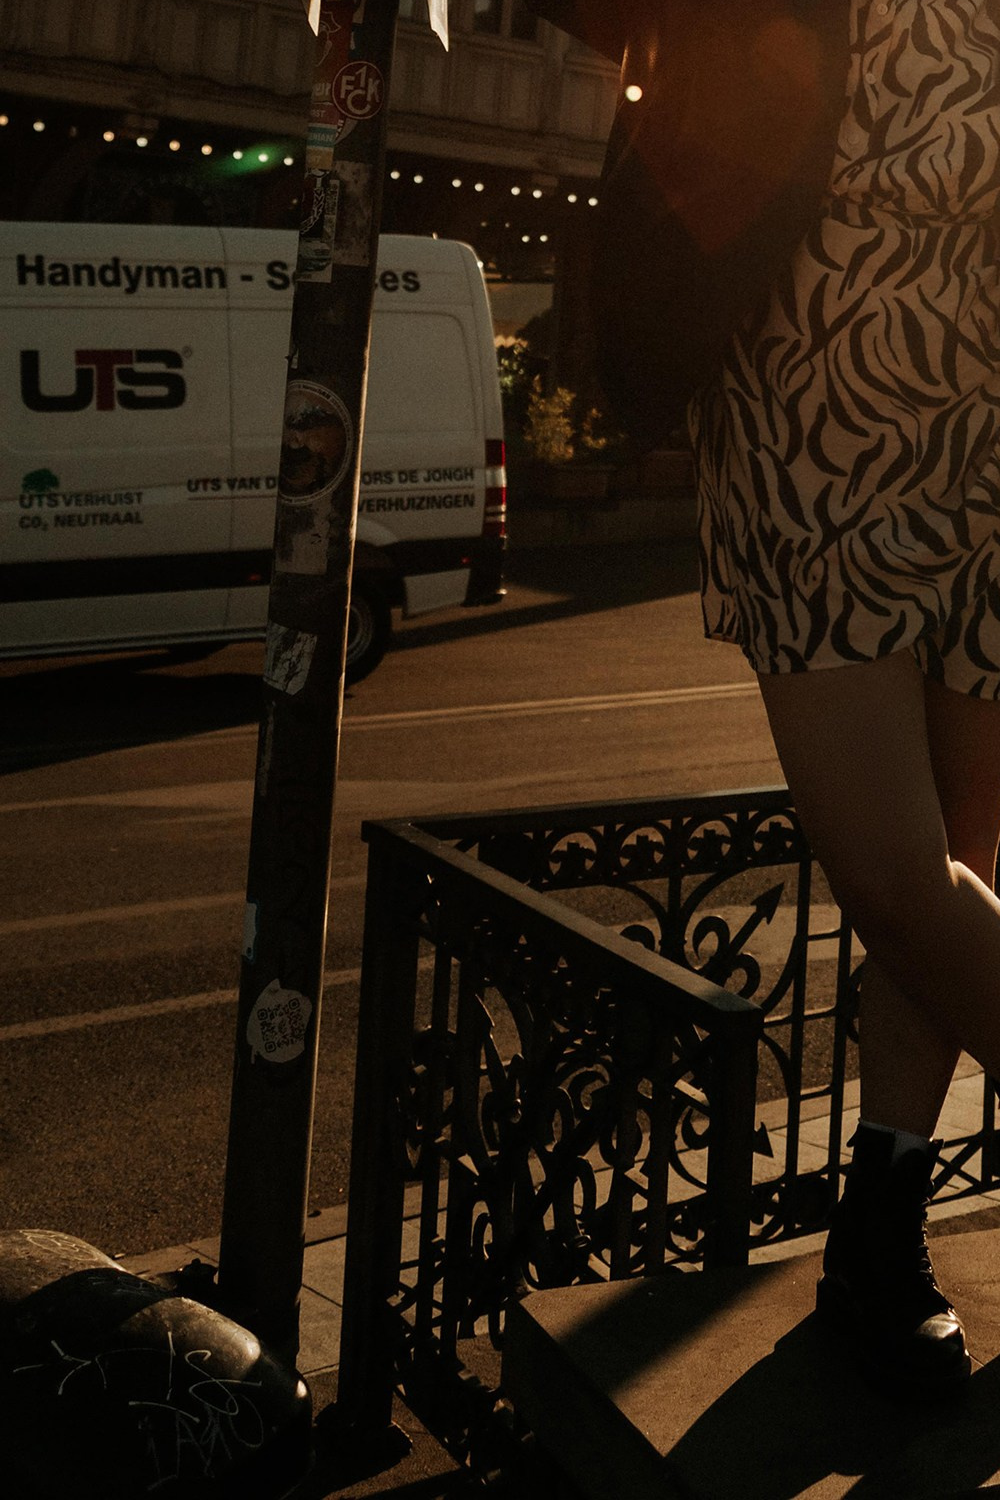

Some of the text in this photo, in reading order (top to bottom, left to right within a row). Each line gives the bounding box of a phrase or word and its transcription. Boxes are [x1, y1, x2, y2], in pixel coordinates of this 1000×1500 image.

[17, 254, 227, 294] Handyman
[20, 350, 186, 413] UTS
[187, 478, 220, 492] UTS
[227, 477, 260, 490] VAN
[398, 469, 418, 483] DE
[423, 467, 474, 482] JONGH
[19, 492, 143, 508] UTS VERHUIST
[54, 512, 143, 527] NEUTRAAL
